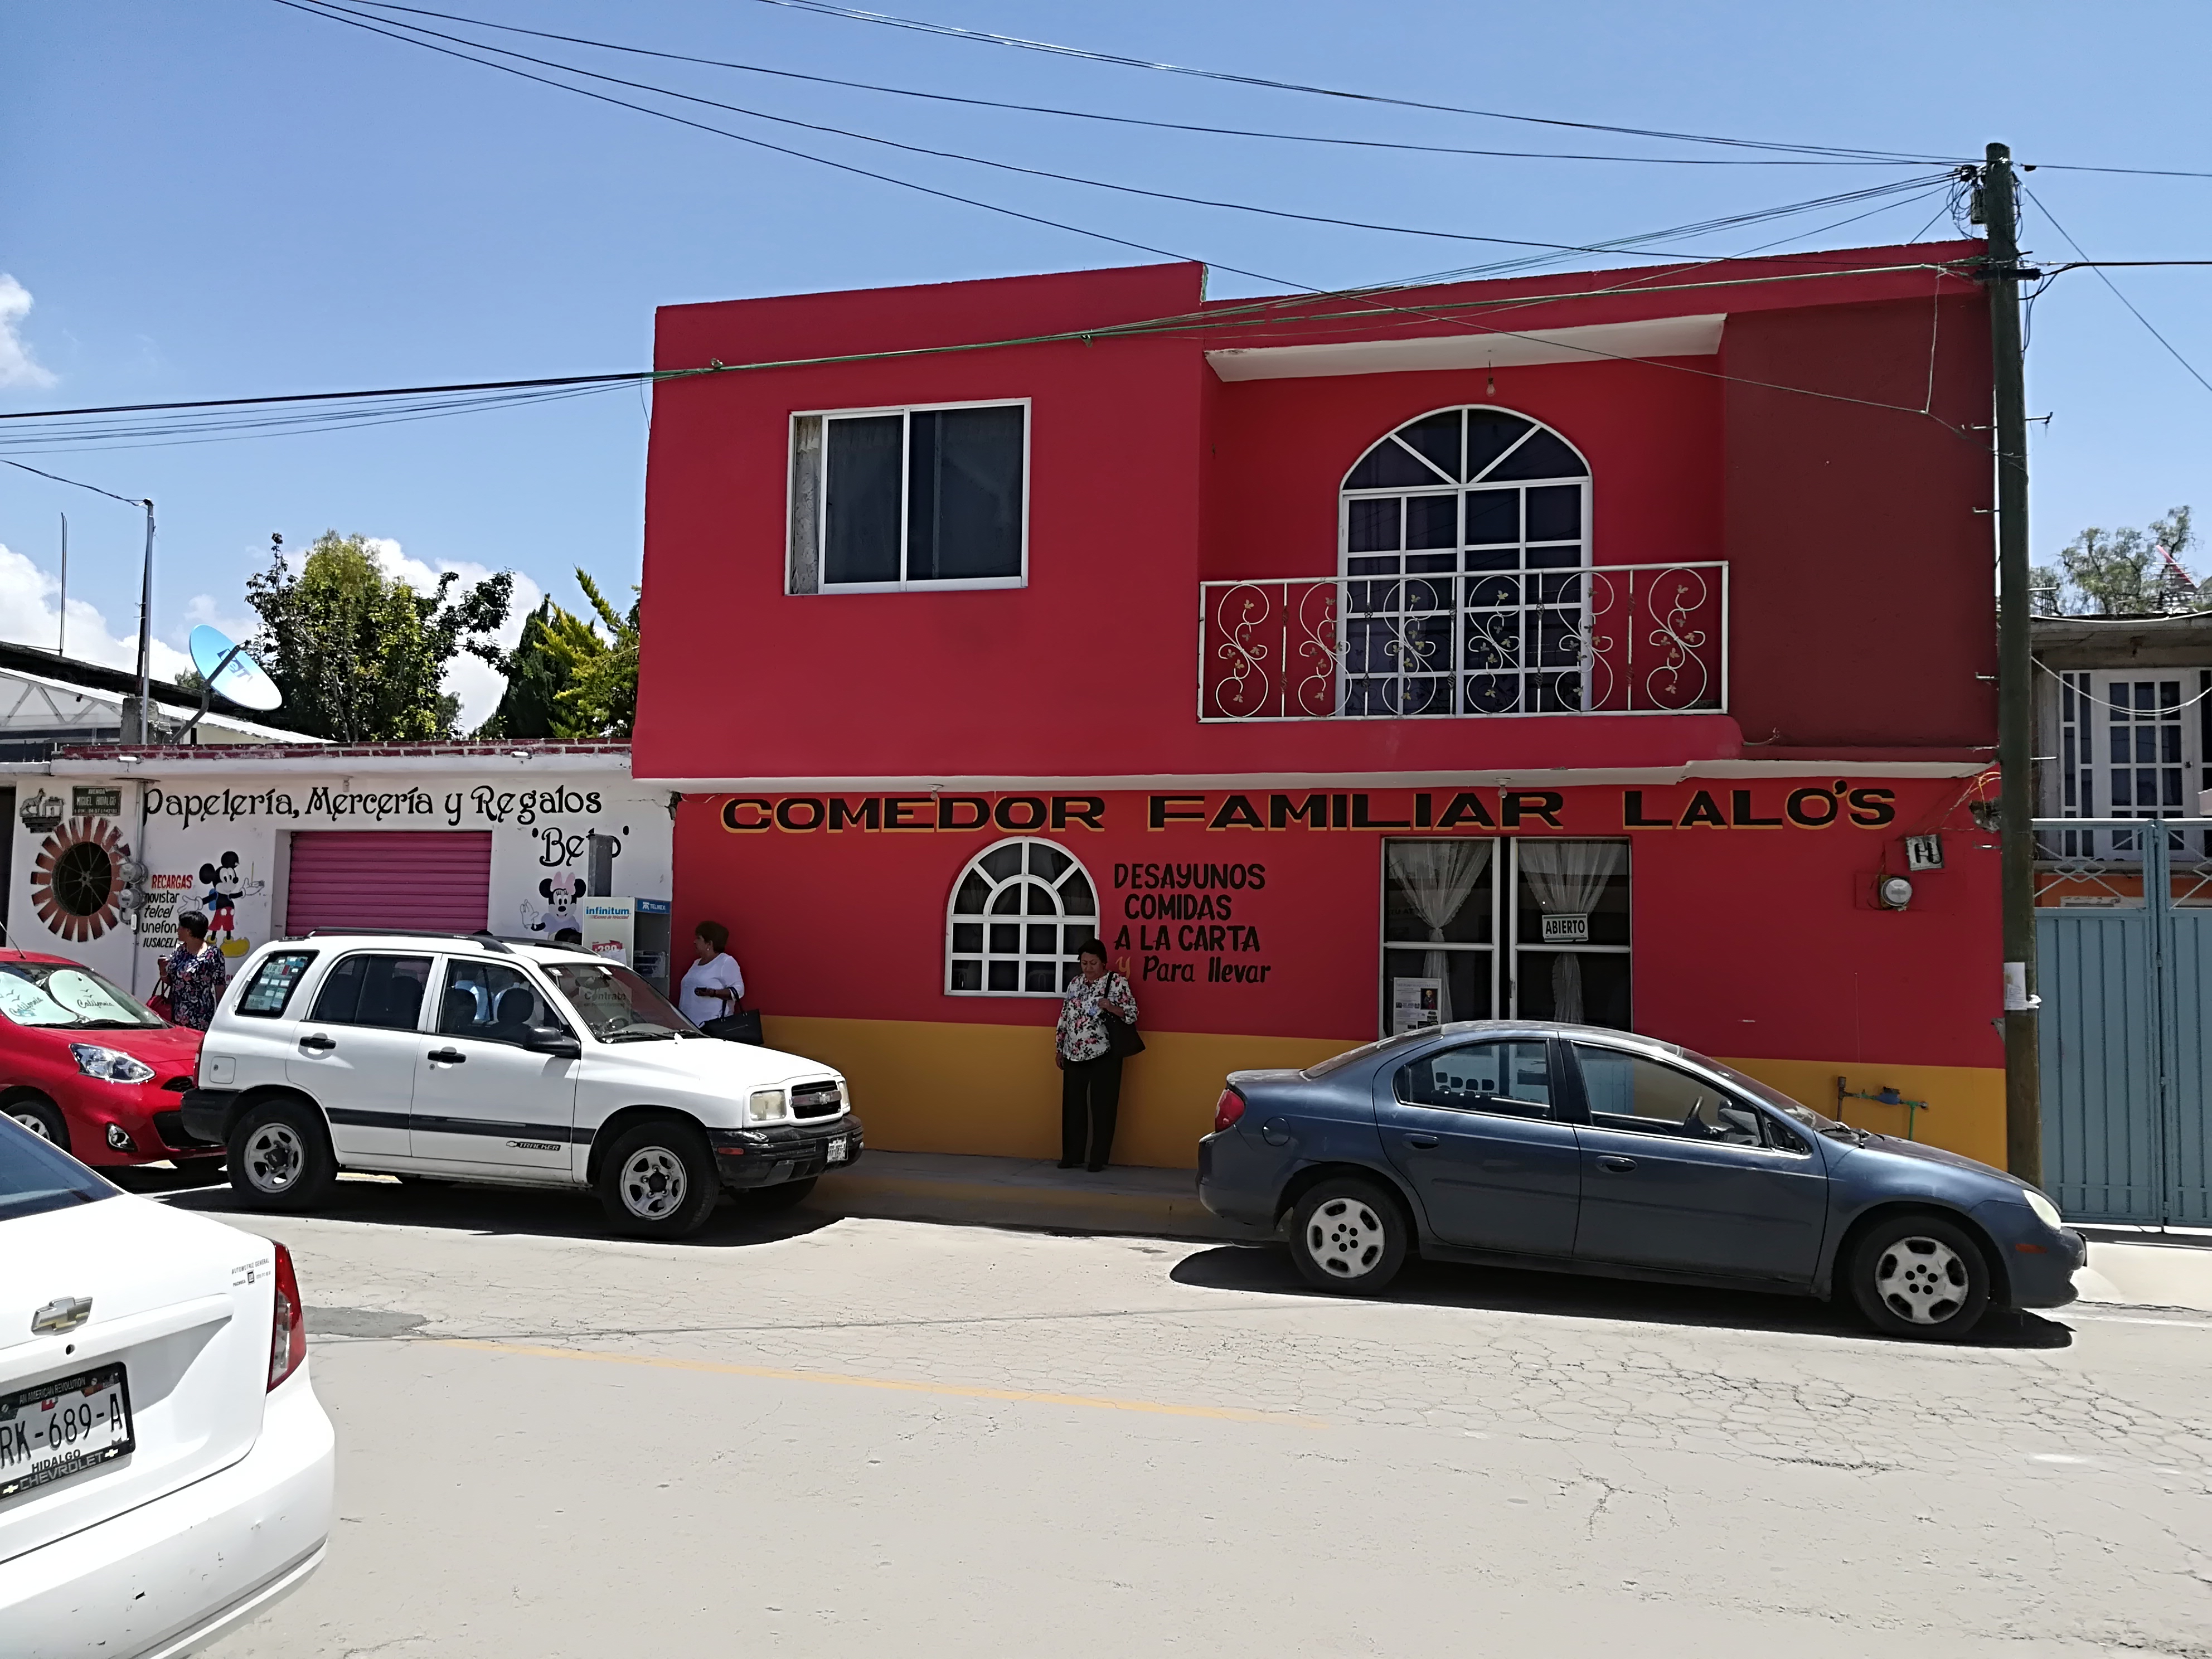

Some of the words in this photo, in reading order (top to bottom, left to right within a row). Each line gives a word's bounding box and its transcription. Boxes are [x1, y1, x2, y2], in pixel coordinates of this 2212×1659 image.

[95, 795, 117, 806] HIDALGO
[143, 788, 300, 830] Papelería,
[305, 787, 434, 822] Mercería
[445, 793, 463, 826] y
[470, 784, 602, 825] Regalos
[720, 796, 1105, 833] COMEDOR
[1147, 792, 1564, 832] FAMILIAR
[1622, 779, 1895, 830] LALO'S
[151, 875, 193, 890] RECARGAS
[1114, 863, 1266, 890] DESAYUNOS
[144, 905, 174, 918] telcel
[586, 906, 629, 915] infinitum
[1124, 893, 1233, 921] COMIDAS
[142, 920, 177, 934] unefon
[1114, 925, 1131, 951] A
[1140, 925, 1171, 951] LA
[1178, 925, 1260, 952] CARTA
[1545, 920, 1585, 934] ABIERTO
[1143, 955, 1196, 983] Para
[1208, 957, 1271, 983] llevar
[520, 1142, 559, 1151] TRACKER
[231, 1262, 254, 1275] AUTOMOTRIZ
[255, 1258, 270, 1267] GENERAL
[20, 1394, 27, 1404] AN
[28, 1386, 54, 1402] AMERICAN
[55, 1376, 86, 1394] REVOLUTION
[20, 1451, 104, 1492] CHEVROLET
[32, 1449, 81, 1473] HIDALGO
